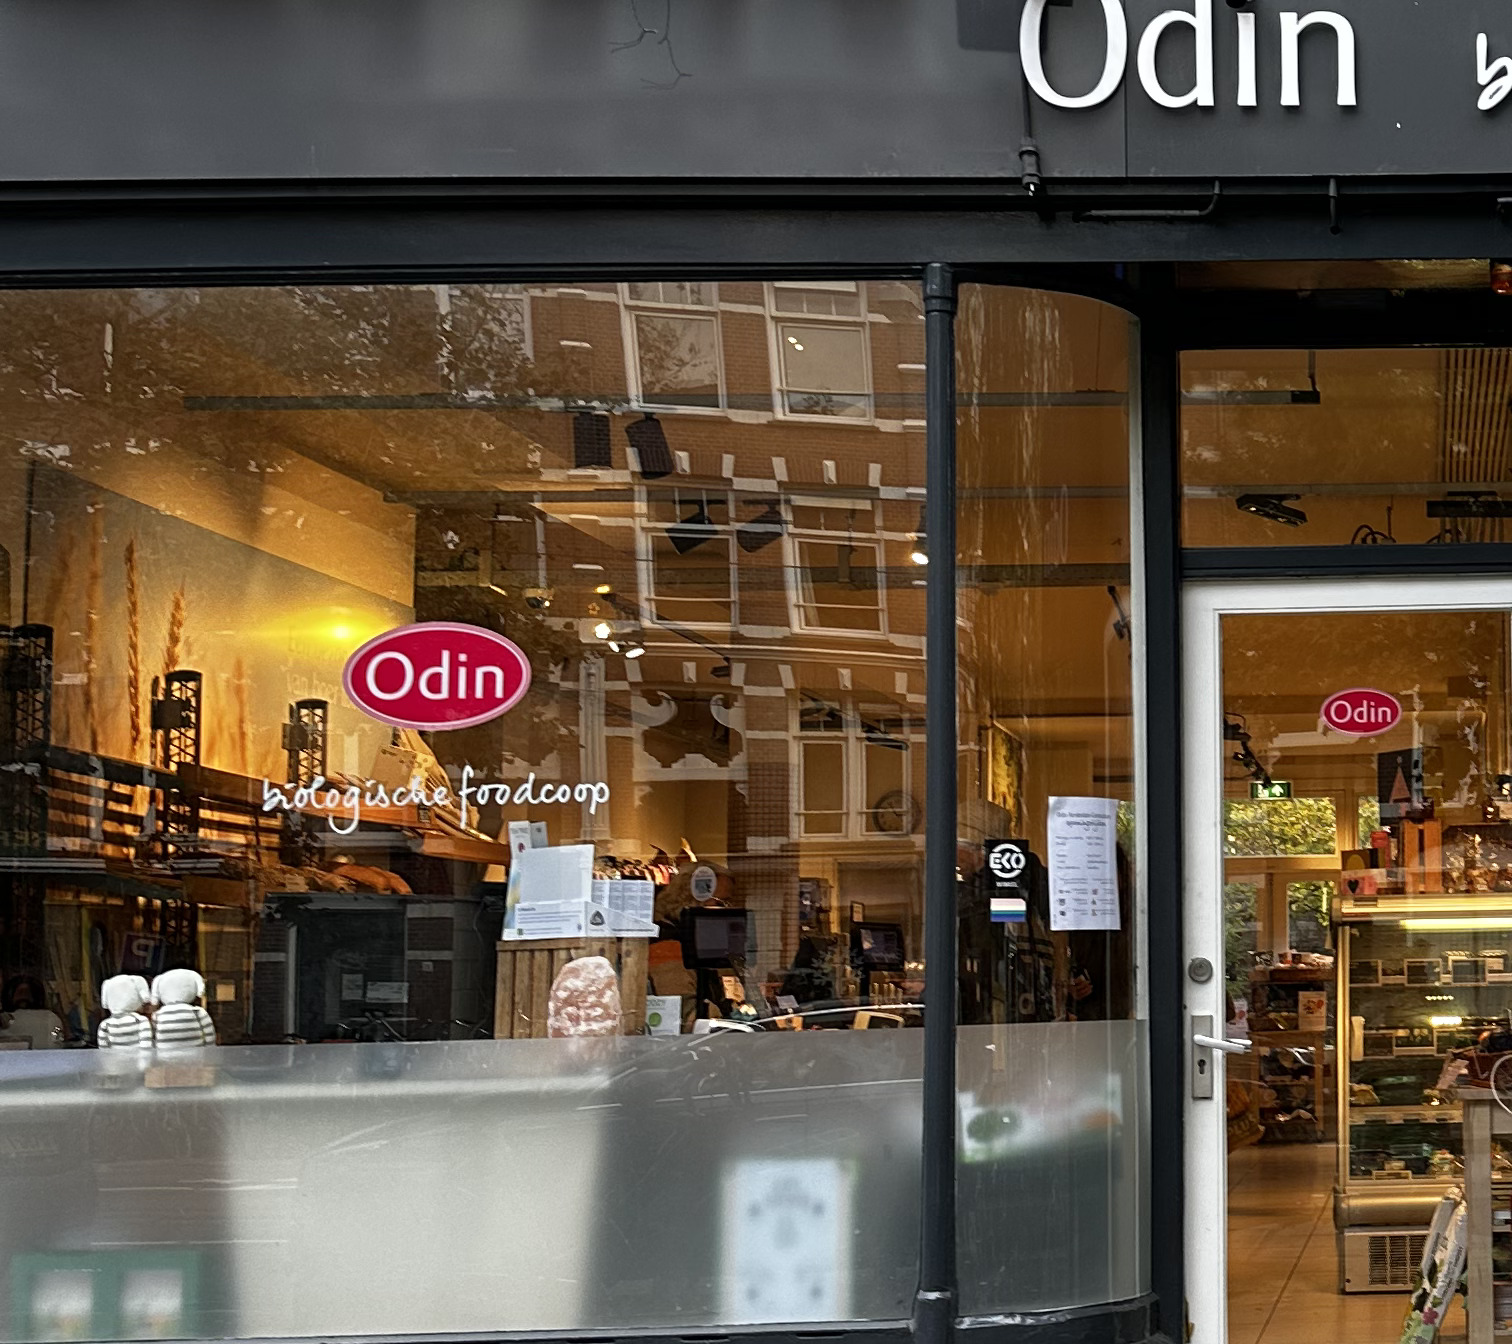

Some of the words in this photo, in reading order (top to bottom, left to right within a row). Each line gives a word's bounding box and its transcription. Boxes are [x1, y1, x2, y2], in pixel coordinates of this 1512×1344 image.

[366, 649, 505, 701] Odin
[1329, 699, 1392, 724] Odin
[262, 774, 453, 835] biologische
[458, 764, 611, 829] foodcoop
[988, 851, 1027, 870] EKO
